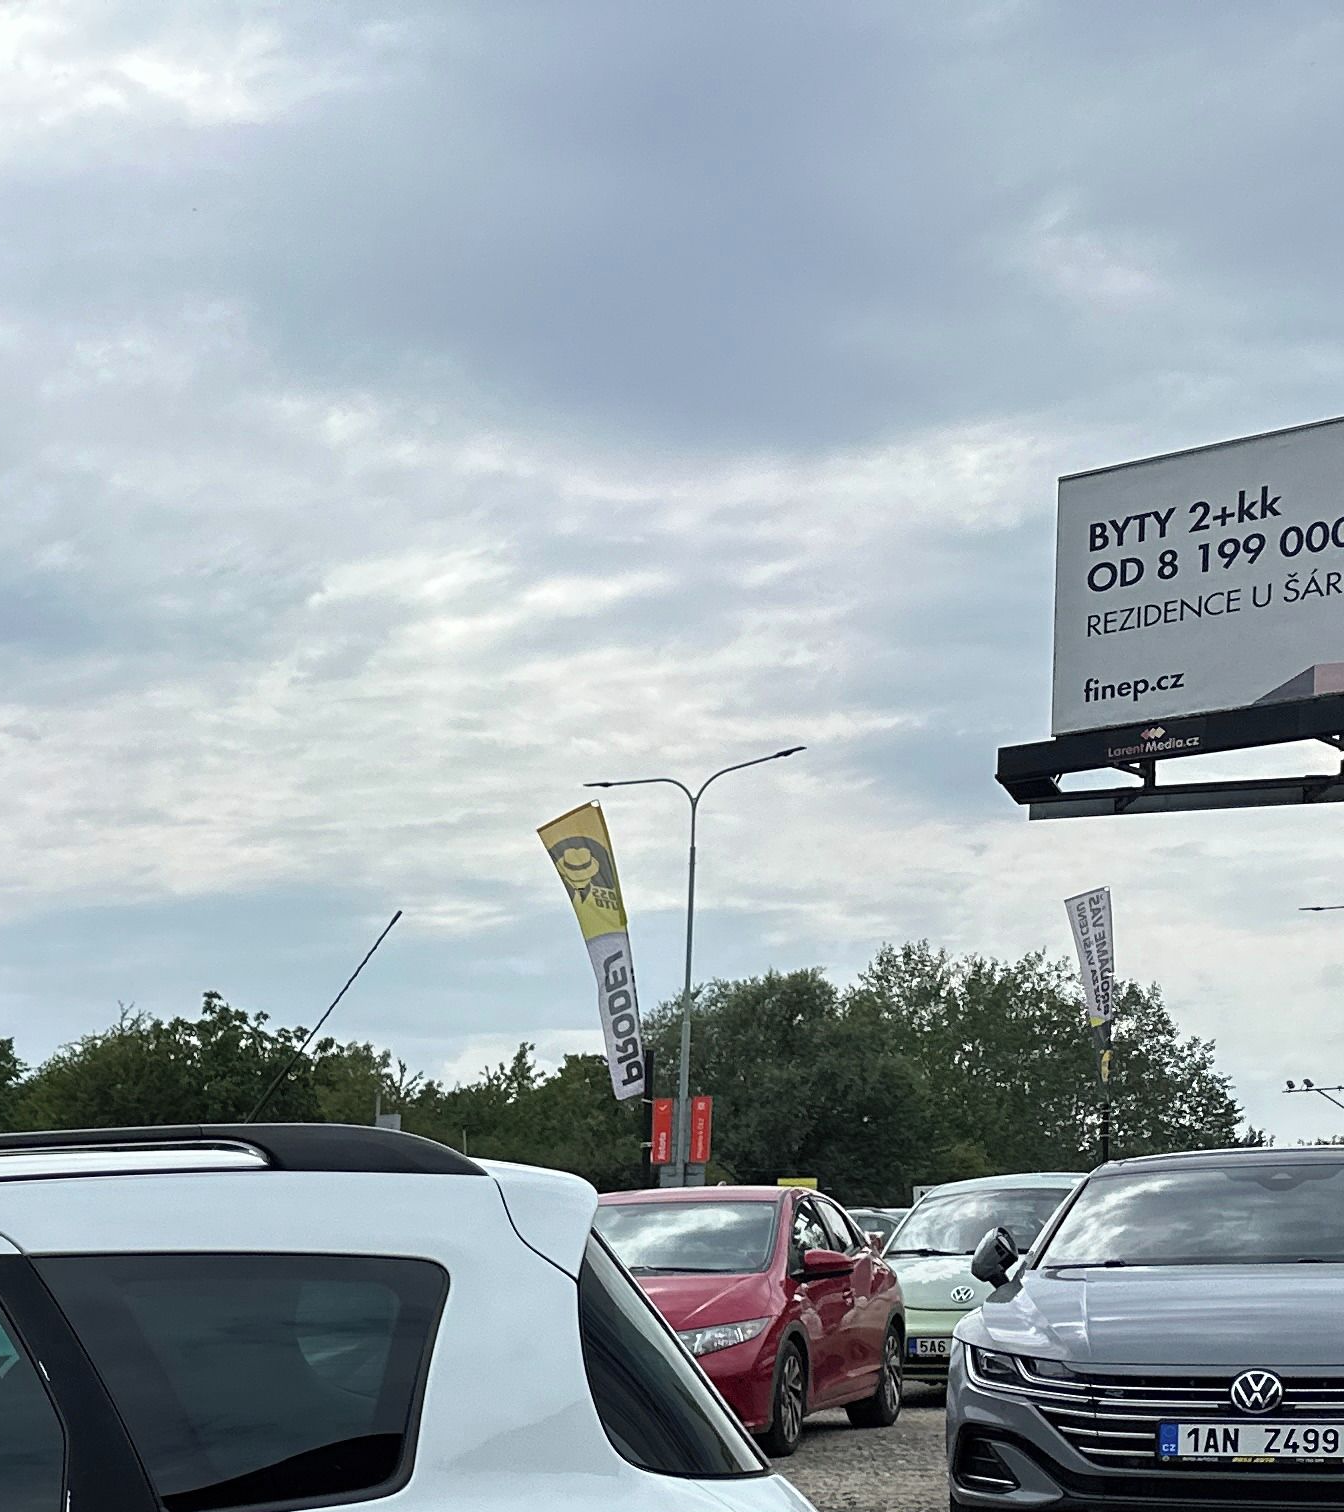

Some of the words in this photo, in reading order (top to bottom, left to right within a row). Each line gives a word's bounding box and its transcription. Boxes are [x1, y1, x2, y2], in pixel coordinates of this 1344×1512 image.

[1089, 507, 1176, 552] BYTY
[1189, 485, 1282, 533] 2+kk
[1087, 556, 1144, 592] OD
[1157, 549, 1178, 580] 8
[1198, 533, 1266, 573] 199
[1087, 588, 1242, 637] REZIDENCE
[1252, 583, 1272, 608] U
[1283, 568, 1344, 603] ŠÁR
[1084, 673, 1184, 703] finep.cz
[1107, 736, 1200, 758] LarentMedia.cz
[920, 1340, 946, 1353] 5A6
[1162, 1444, 1176, 1452] CZ
[1186, 1427, 1239, 1453] 1AN
[1264, 1428, 1340, 1454] Z499
